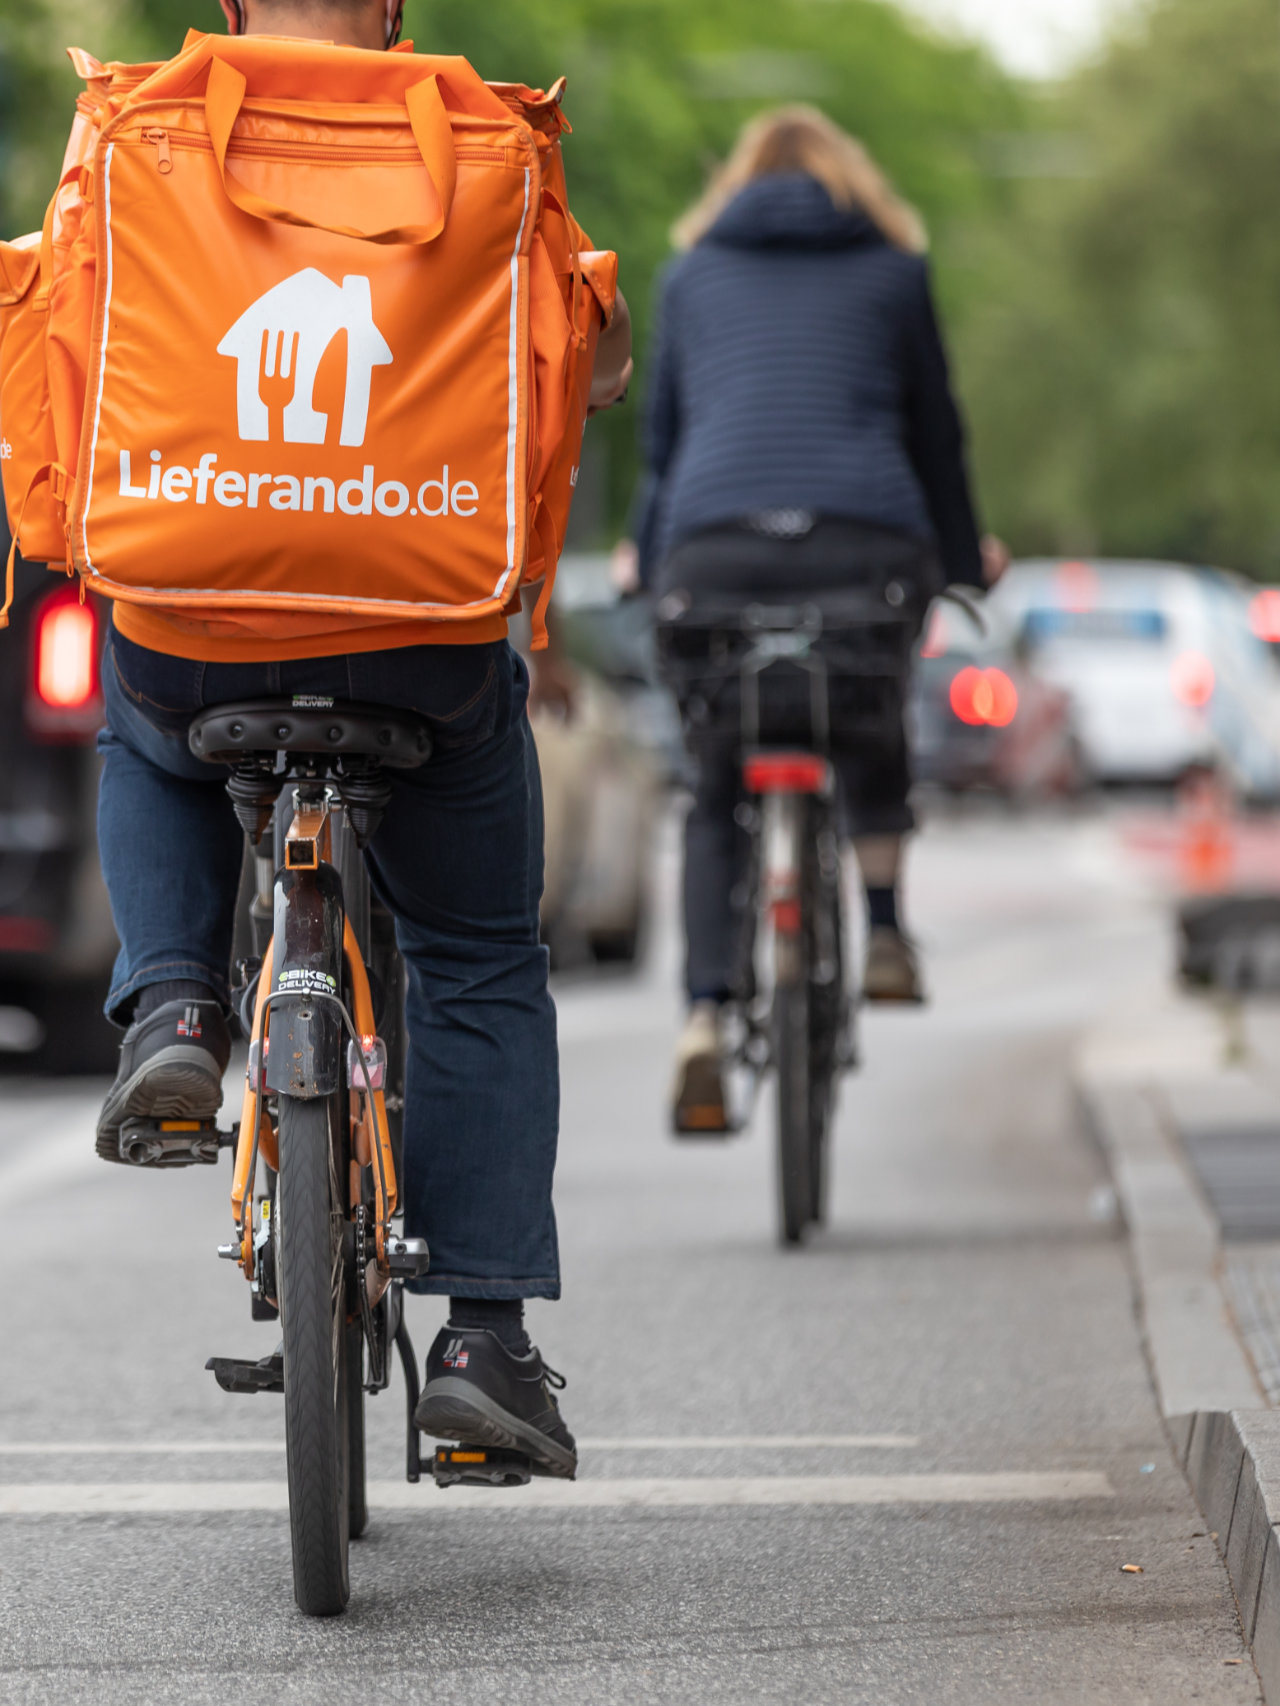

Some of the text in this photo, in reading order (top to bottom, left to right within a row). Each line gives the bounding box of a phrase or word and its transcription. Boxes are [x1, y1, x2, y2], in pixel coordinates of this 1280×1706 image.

[119, 449, 480, 517] Lieferando.de
[292, 700, 334, 708] DELIVERY
[278, 980, 336, 995] DELIVERY
